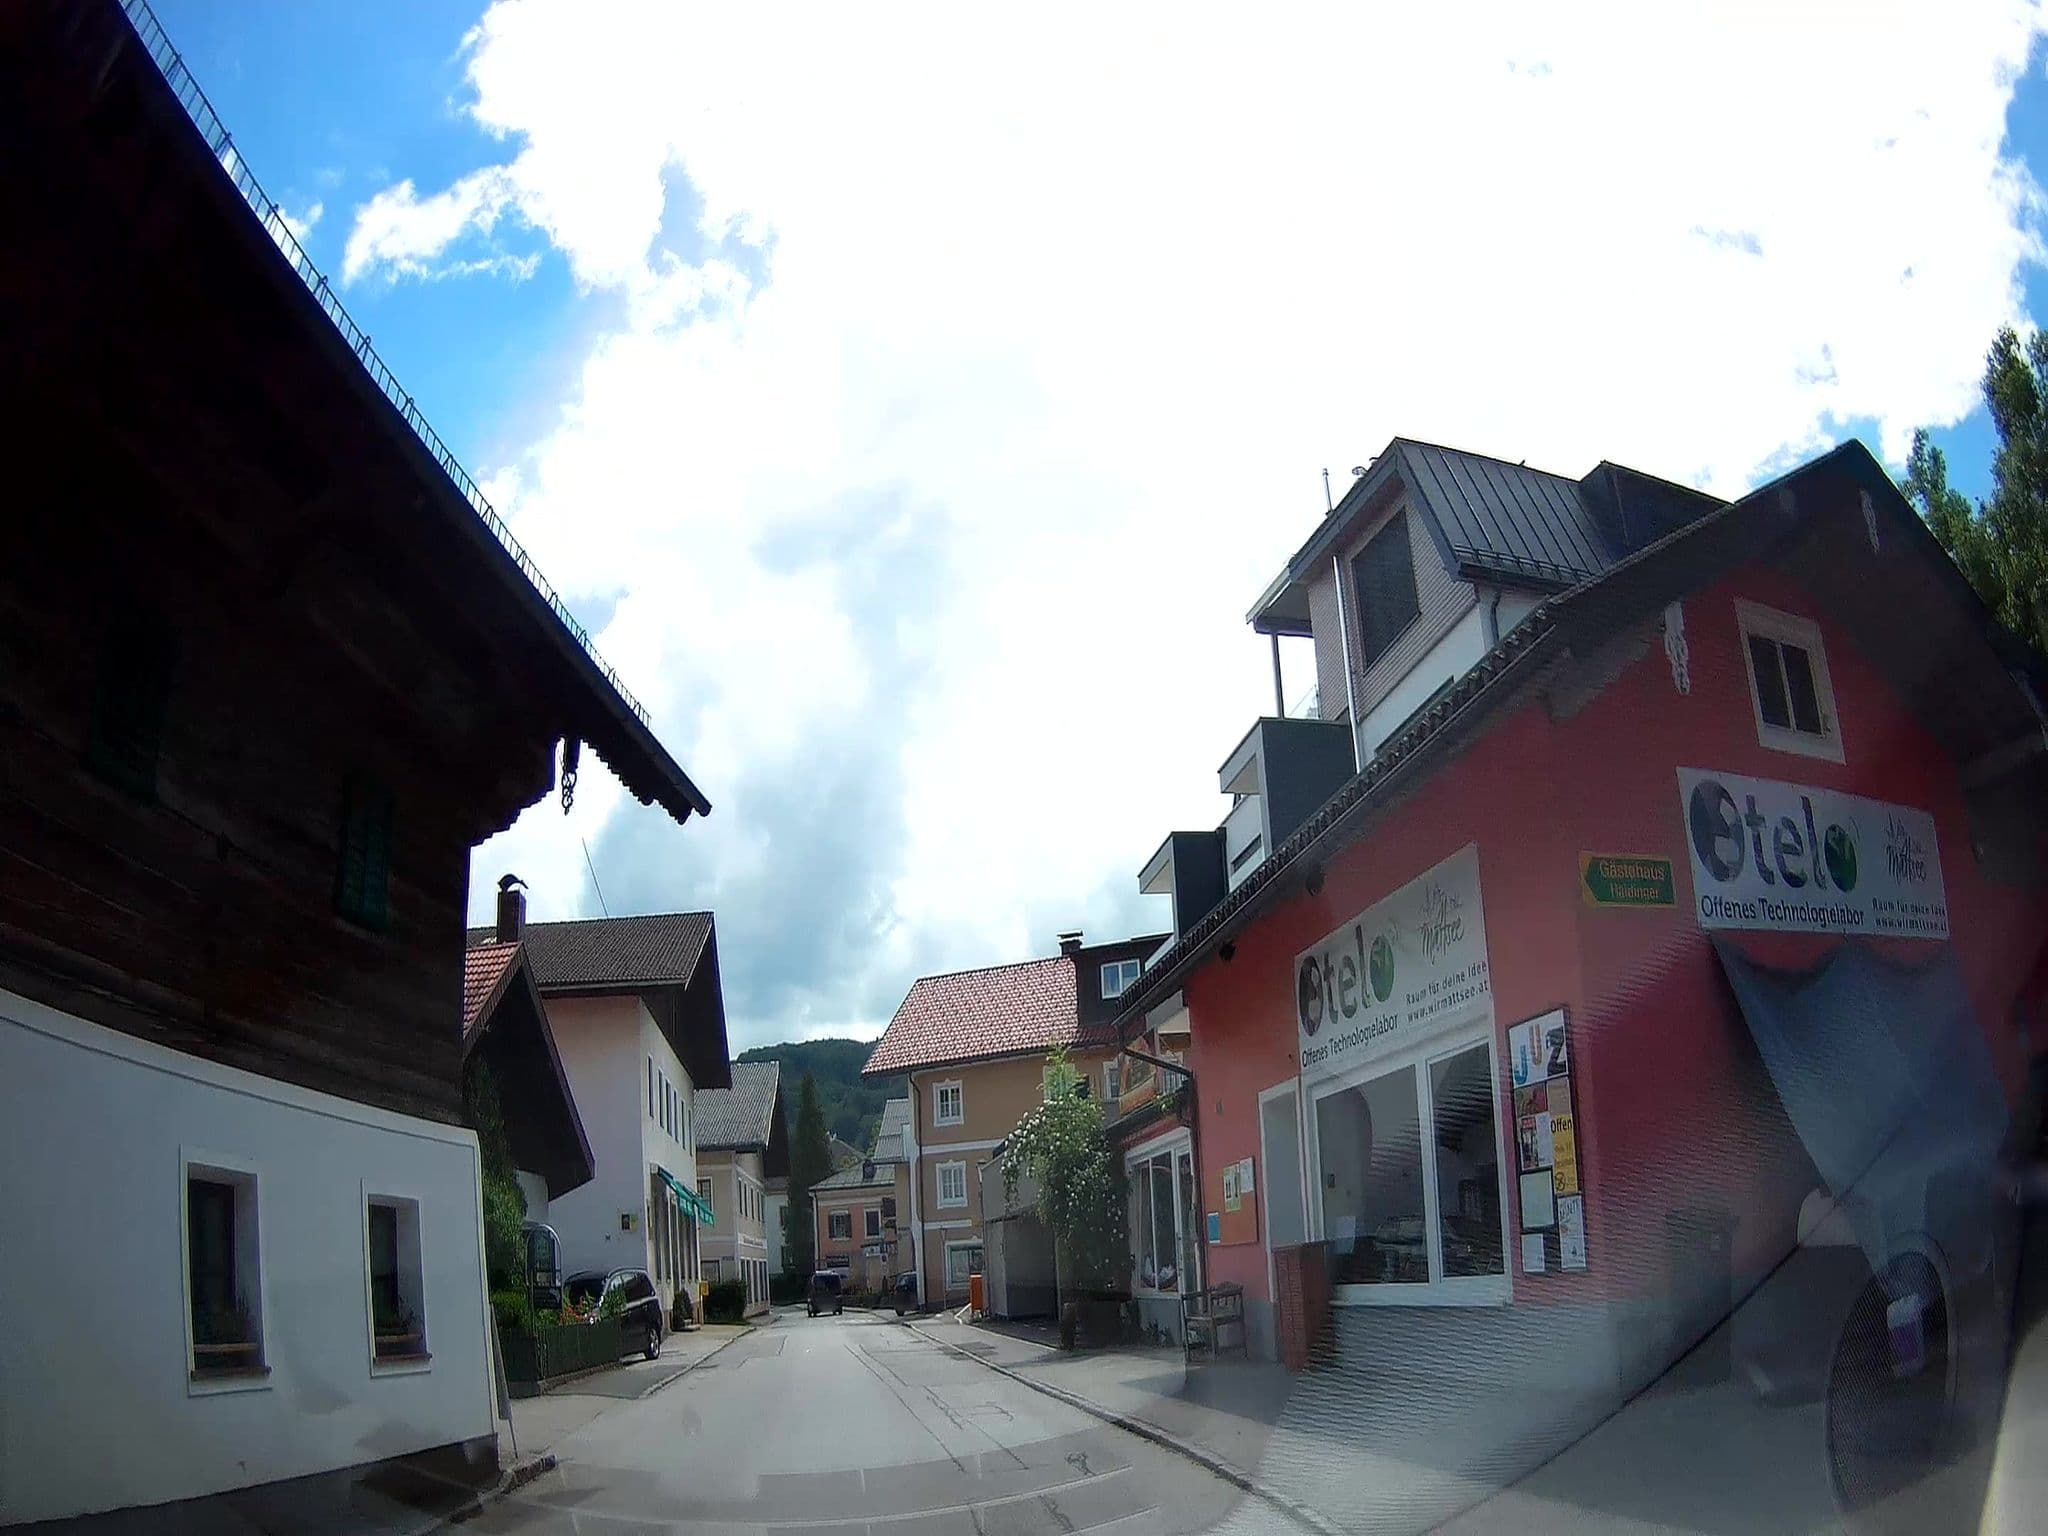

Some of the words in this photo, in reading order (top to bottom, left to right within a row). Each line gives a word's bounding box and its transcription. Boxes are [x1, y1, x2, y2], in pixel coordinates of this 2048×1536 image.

[1701, 895, 1756, 919] Offenes
[1758, 897, 1864, 928] Technologielabor
[1406, 987, 1427, 1005] Raum
[1468, 960, 1488, 979] Idee
[1302, 1045, 1329, 1068] Offenes
[1329, 1012, 1399, 1057] Technologielabor
[1551, 1117, 1573, 1134] Offen
